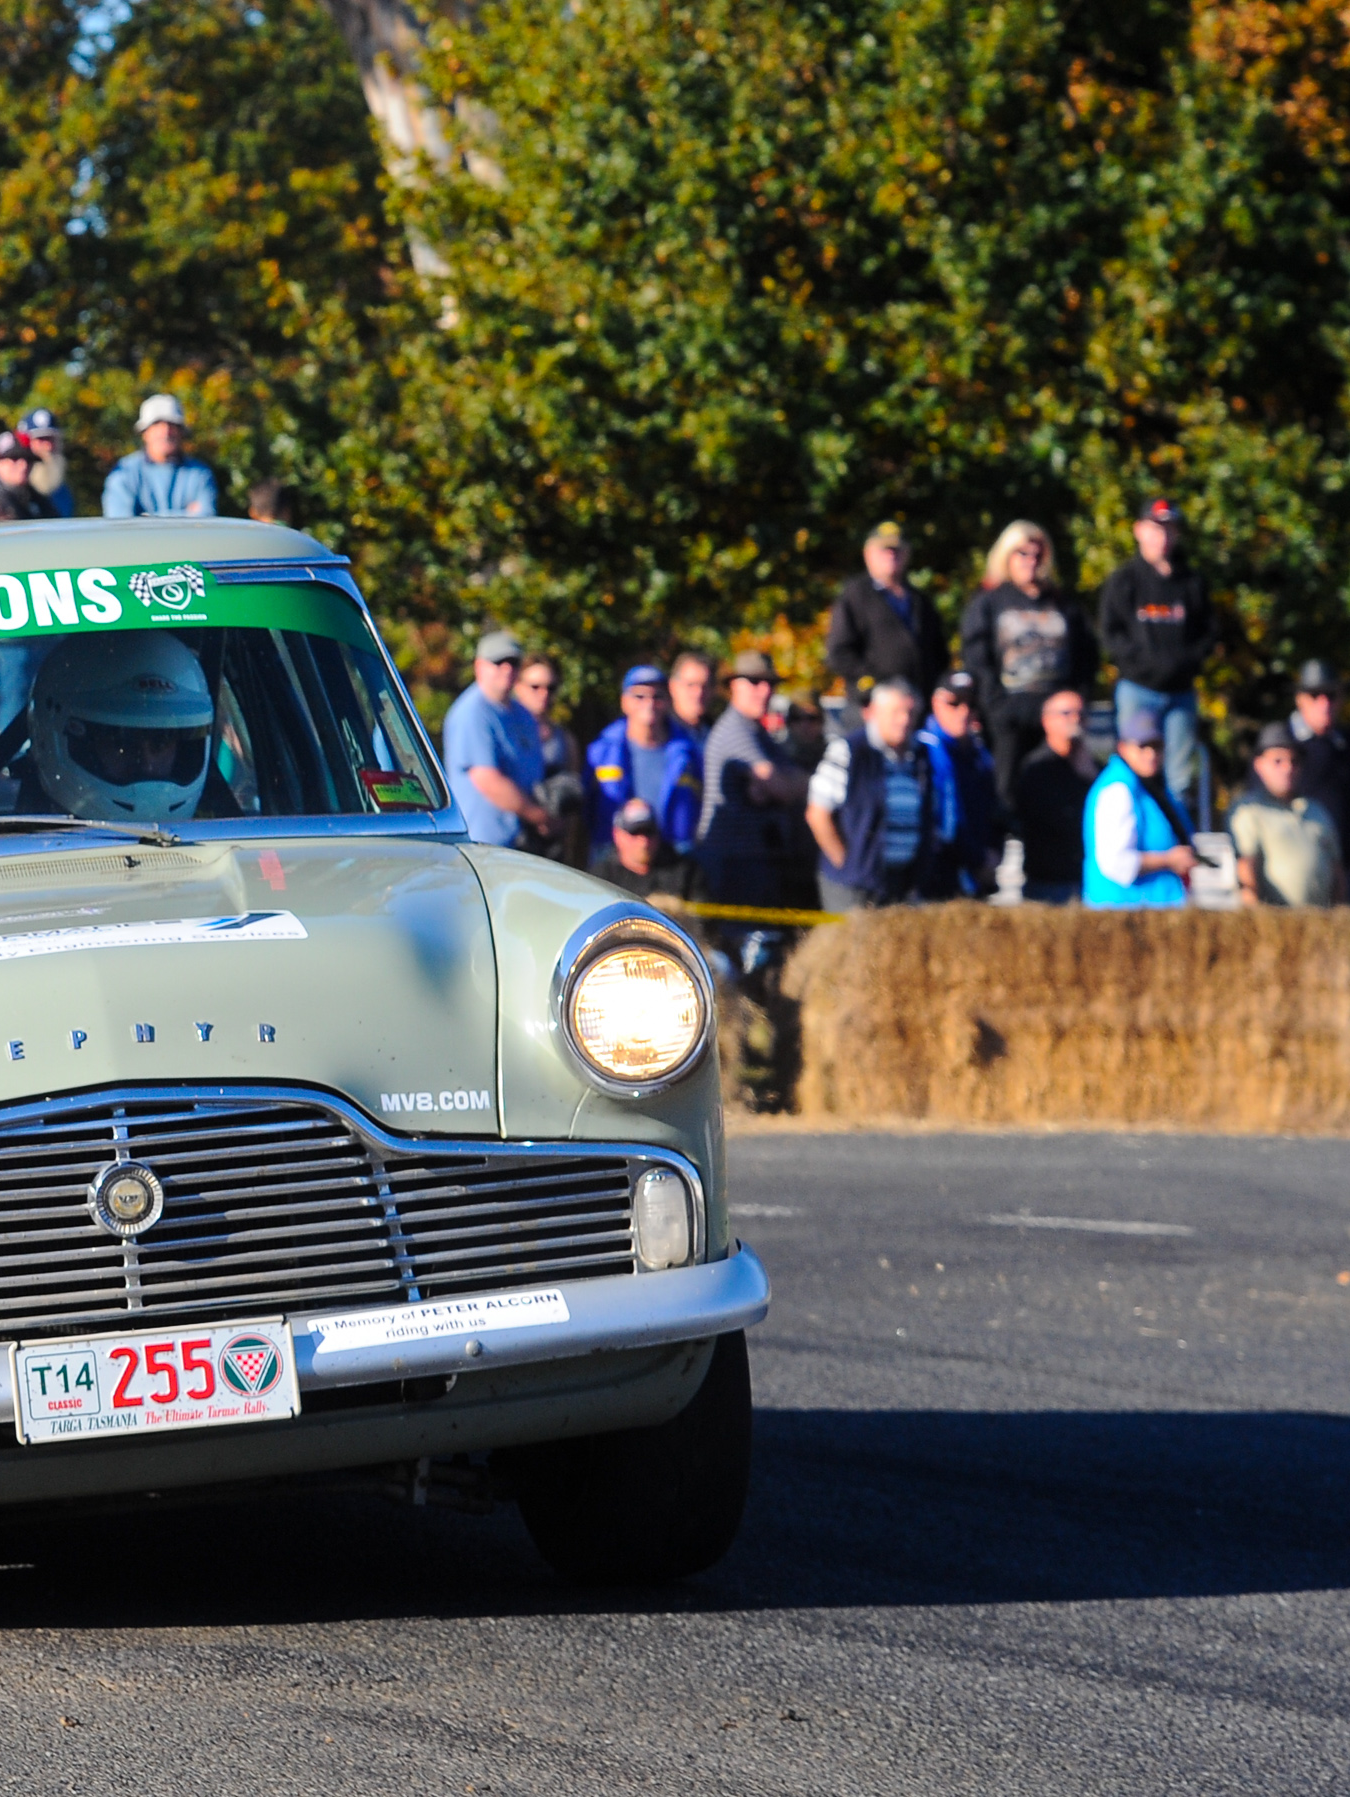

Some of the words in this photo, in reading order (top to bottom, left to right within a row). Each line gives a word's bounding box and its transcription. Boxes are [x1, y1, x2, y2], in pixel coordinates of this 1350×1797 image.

[314, 1322, 330, 1333] In
[334, 1314, 396, 1330] Memory
[401, 1309, 416, 1322] of
[419, 1302, 480, 1318] PETER
[485, 1292, 560, 1311] ALCORN
[384, 1322, 429, 1340] riding
[433, 1317, 465, 1333] with
[469, 1316, 487, 1327] us
[31, 1361, 95, 1396] T14
[107, 1338, 217, 1409] 255
[47, 1398, 83, 1411] CLASSIC
[50, 1418, 83, 1435] TARGA
[87, 1412, 138, 1431] TASMANIA
[144, 1410, 162, 1425] The
[164, 1407, 204, 1424] Ultimate
[206, 1403, 240, 1419] Tarmac
[243, 1400, 268, 1416] Rally
